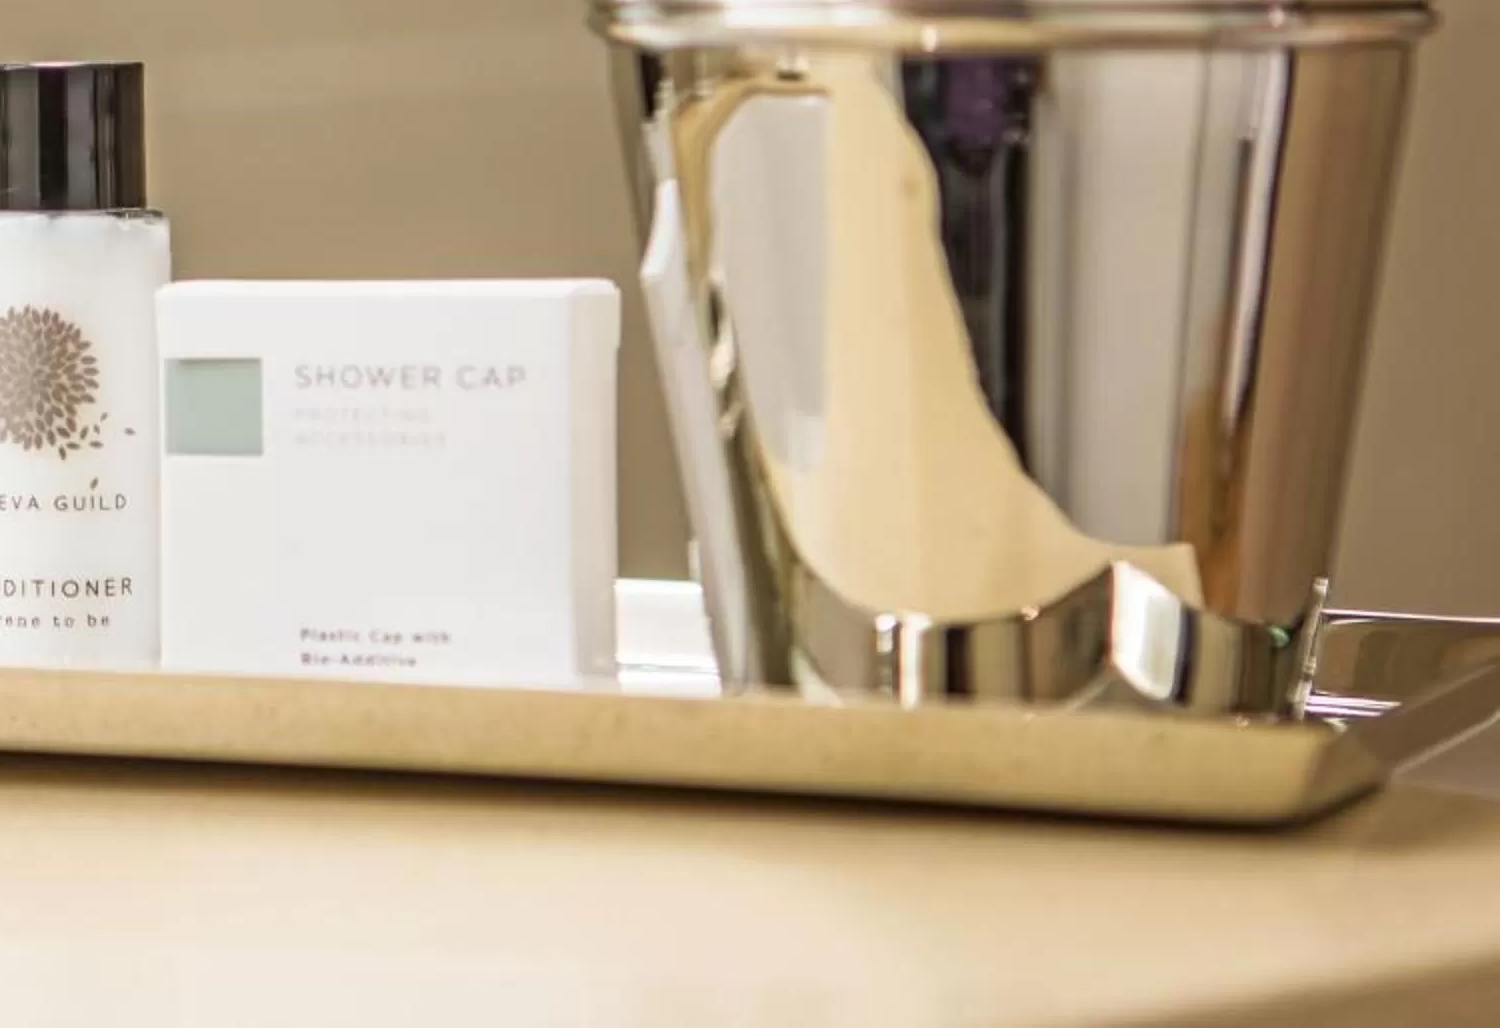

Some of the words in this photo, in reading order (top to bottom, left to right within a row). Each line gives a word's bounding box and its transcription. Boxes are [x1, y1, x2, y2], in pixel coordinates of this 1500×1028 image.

[293, 363, 442, 390] SHOWER
[455, 363, 527, 390] CAP
[53, 492, 128, 512] GUILD
[52, 613, 76, 629] to
[87, 613, 111, 628] be
[300, 627, 361, 643] Plastic
[368, 627, 404, 645] Cap
[411, 628, 452, 645] with
